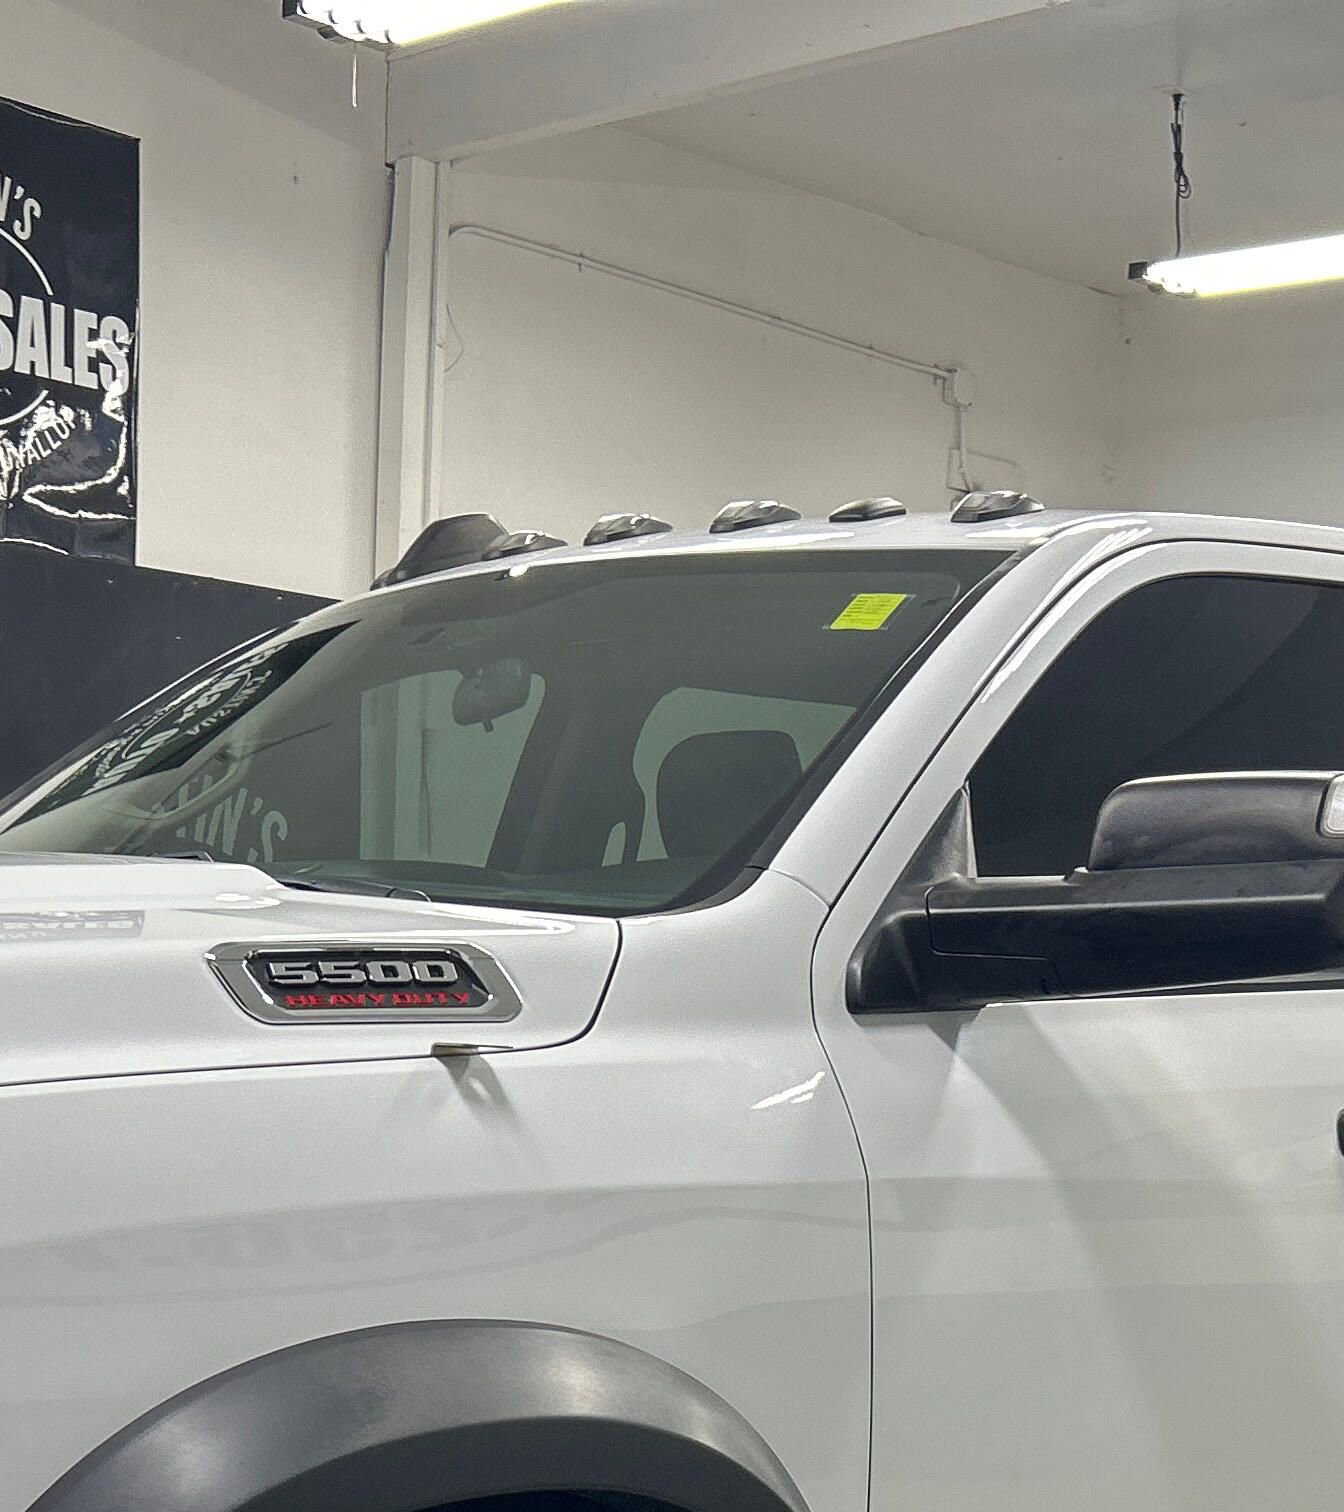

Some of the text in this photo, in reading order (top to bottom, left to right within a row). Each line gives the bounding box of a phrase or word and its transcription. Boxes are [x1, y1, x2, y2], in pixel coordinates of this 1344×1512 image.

[268, 960, 459, 985] 5500
[284, 991, 469, 1008] HEAVY DUTY
